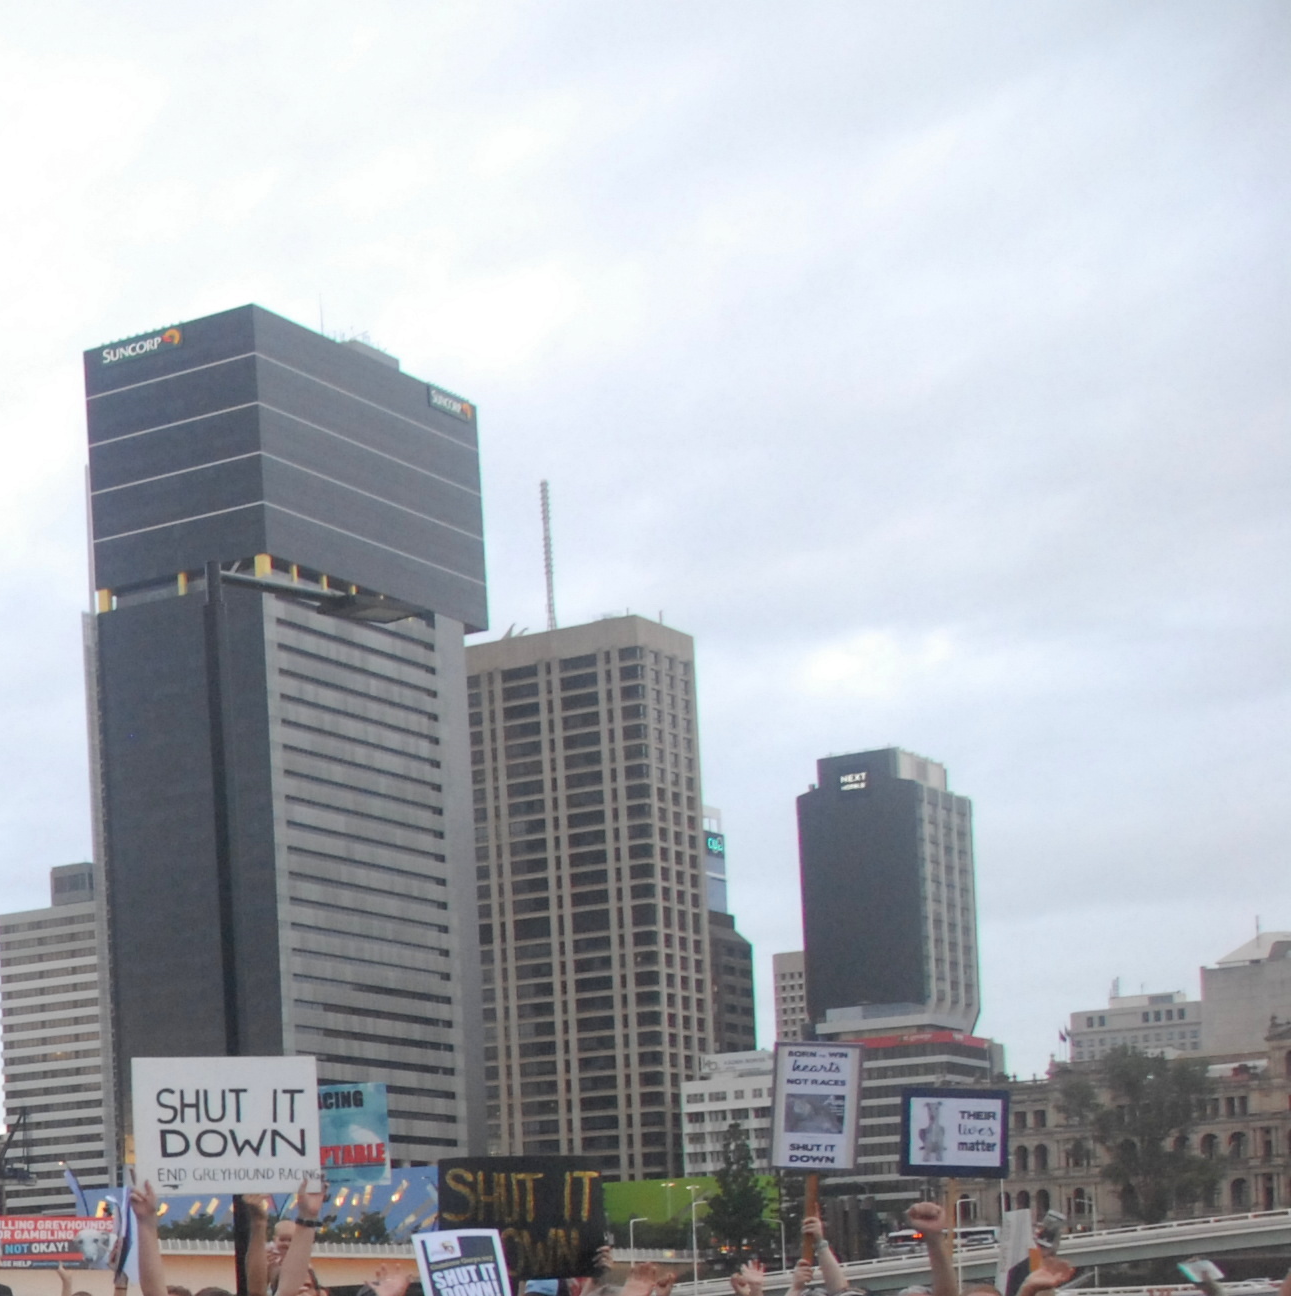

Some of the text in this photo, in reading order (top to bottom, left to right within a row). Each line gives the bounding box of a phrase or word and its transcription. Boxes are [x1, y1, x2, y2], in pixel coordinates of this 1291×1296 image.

[102, 336, 162, 364] SUNCORP
[430, 389, 462, 414] SUNCORP
[840, 771, 867, 783] NEXT
[787, 1050, 817, 1058] BORN
[792, 1059, 841, 1073] hearts
[156, 1087, 305, 1124] SHUT IT
[958, 1110, 997, 1120] THEIR
[958, 1123, 995, 1137] lives
[159, 1128, 306, 1158] DOWN
[789, 1143, 836, 1152] SHUT IT
[957, 1140, 997, 1152] matter
[788, 1155, 836, 1164] DOWN
[157, 1167, 321, 1182] END GREYHOUND RACING
[442, 1167, 601, 1222] SHUT IT
[37, 1220, 113, 1230] GREYHOUNDS
[14, 1230, 74, 1240] GAMBLING
[4, 1242, 69, 1254] NOT OKAY!
[431, 1265, 479, 1289] SHUT
[479, 1263, 496, 1281] IT
